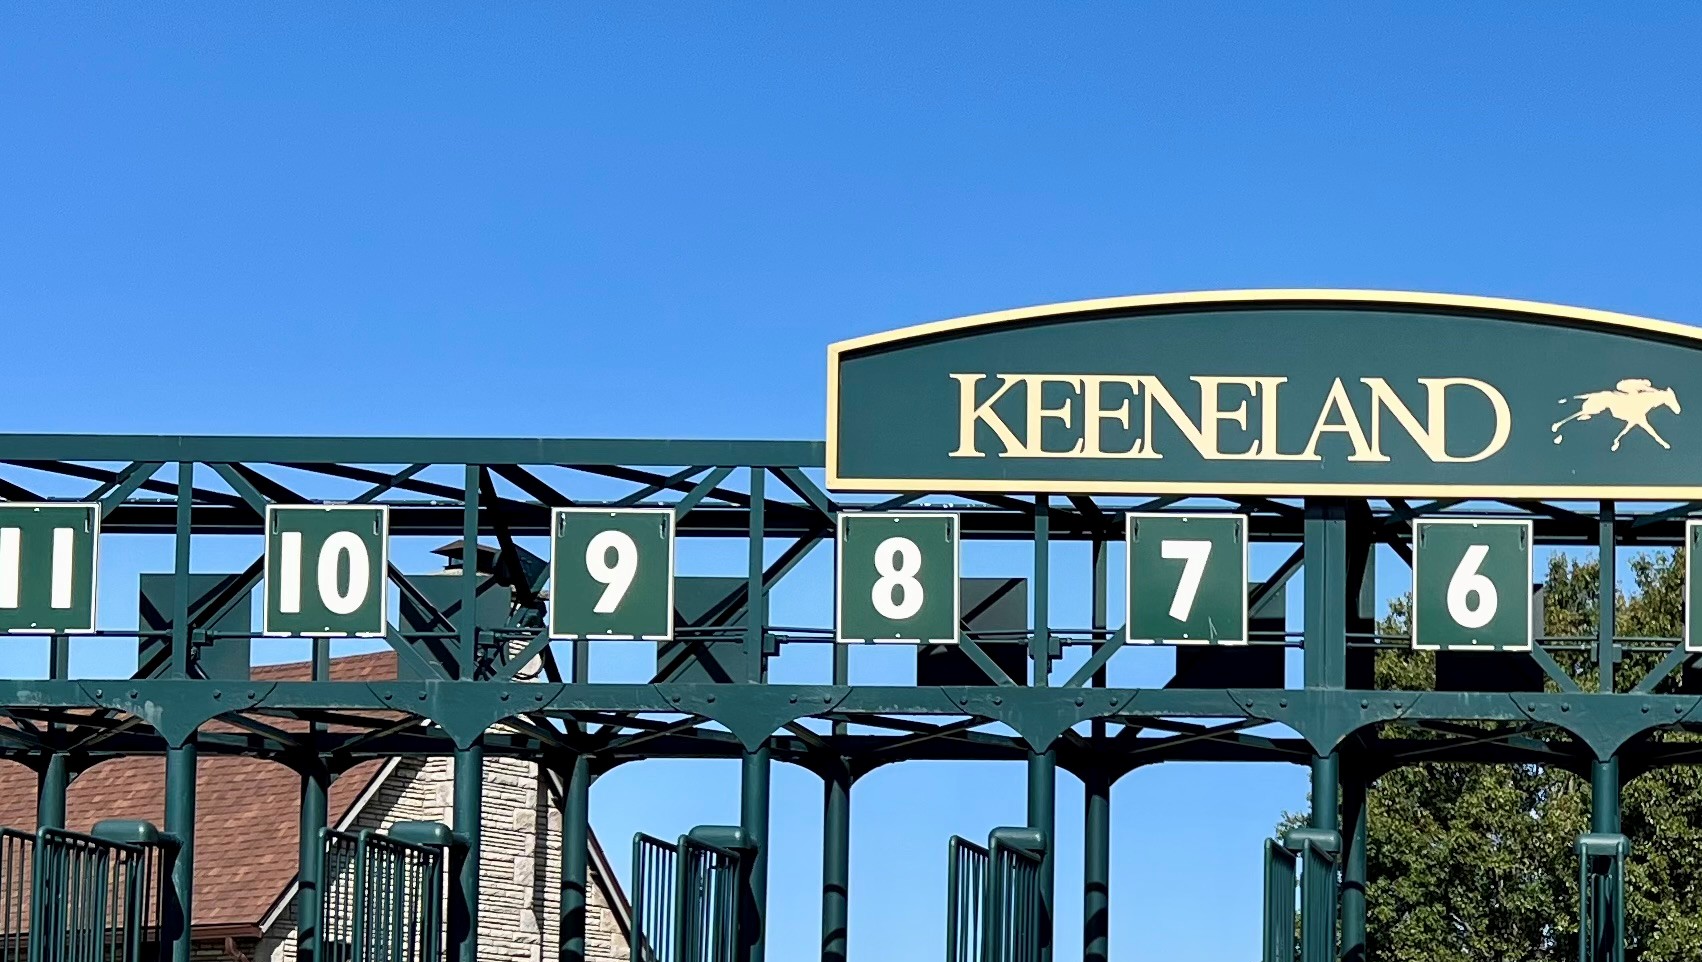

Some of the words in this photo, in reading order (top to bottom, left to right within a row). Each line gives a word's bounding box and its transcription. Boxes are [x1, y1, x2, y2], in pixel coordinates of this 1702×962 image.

[948, 373, 1511, 463] KEENELAND
[0, 527, 74, 609] 11
[280, 530, 370, 615] 10
[585, 530, 638, 614] 9
[871, 536, 924, 620] 8
[1161, 539, 1212, 622] 7
[1446, 544, 1498, 629] 6
